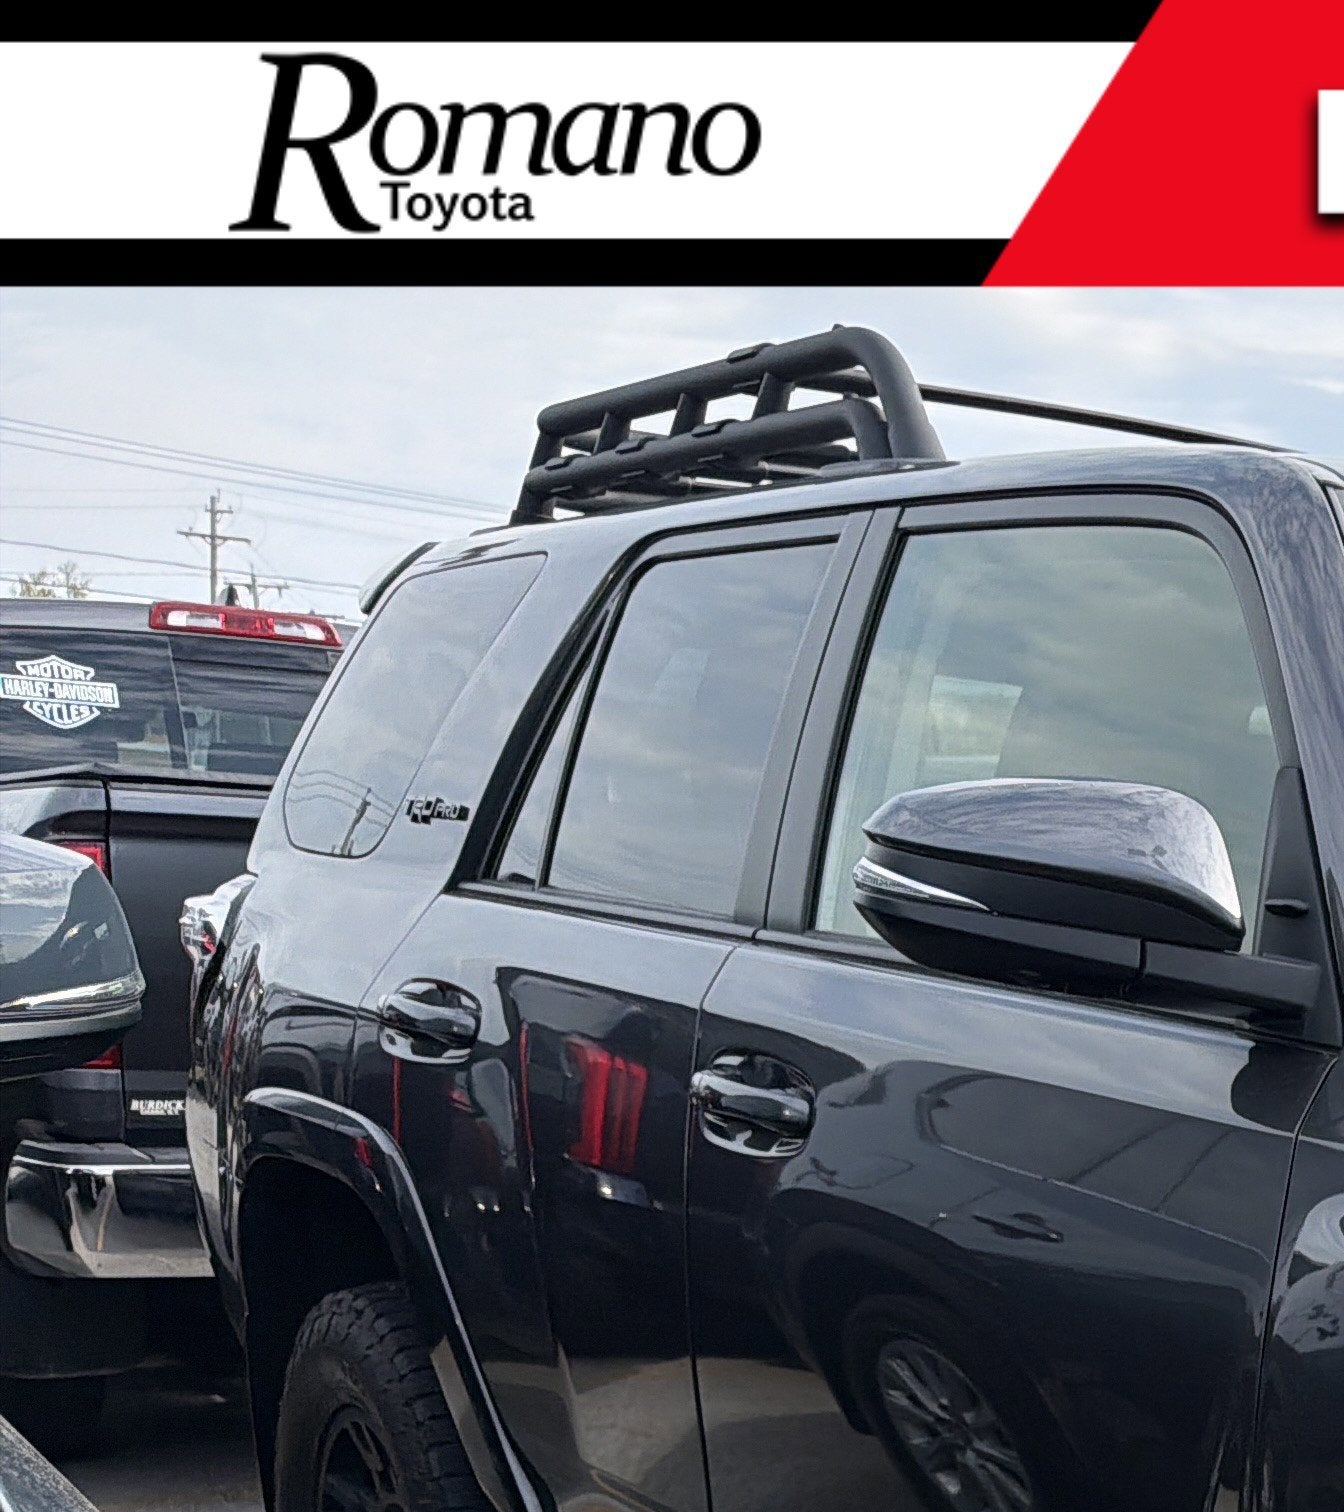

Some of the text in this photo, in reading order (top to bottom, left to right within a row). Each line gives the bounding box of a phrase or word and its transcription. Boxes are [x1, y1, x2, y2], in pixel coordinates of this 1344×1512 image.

[26, 660, 88, 681] MOTOR
[3, 678, 114, 704] HARLEY-DAVIDSON
[32, 701, 92, 725] CYCLES
